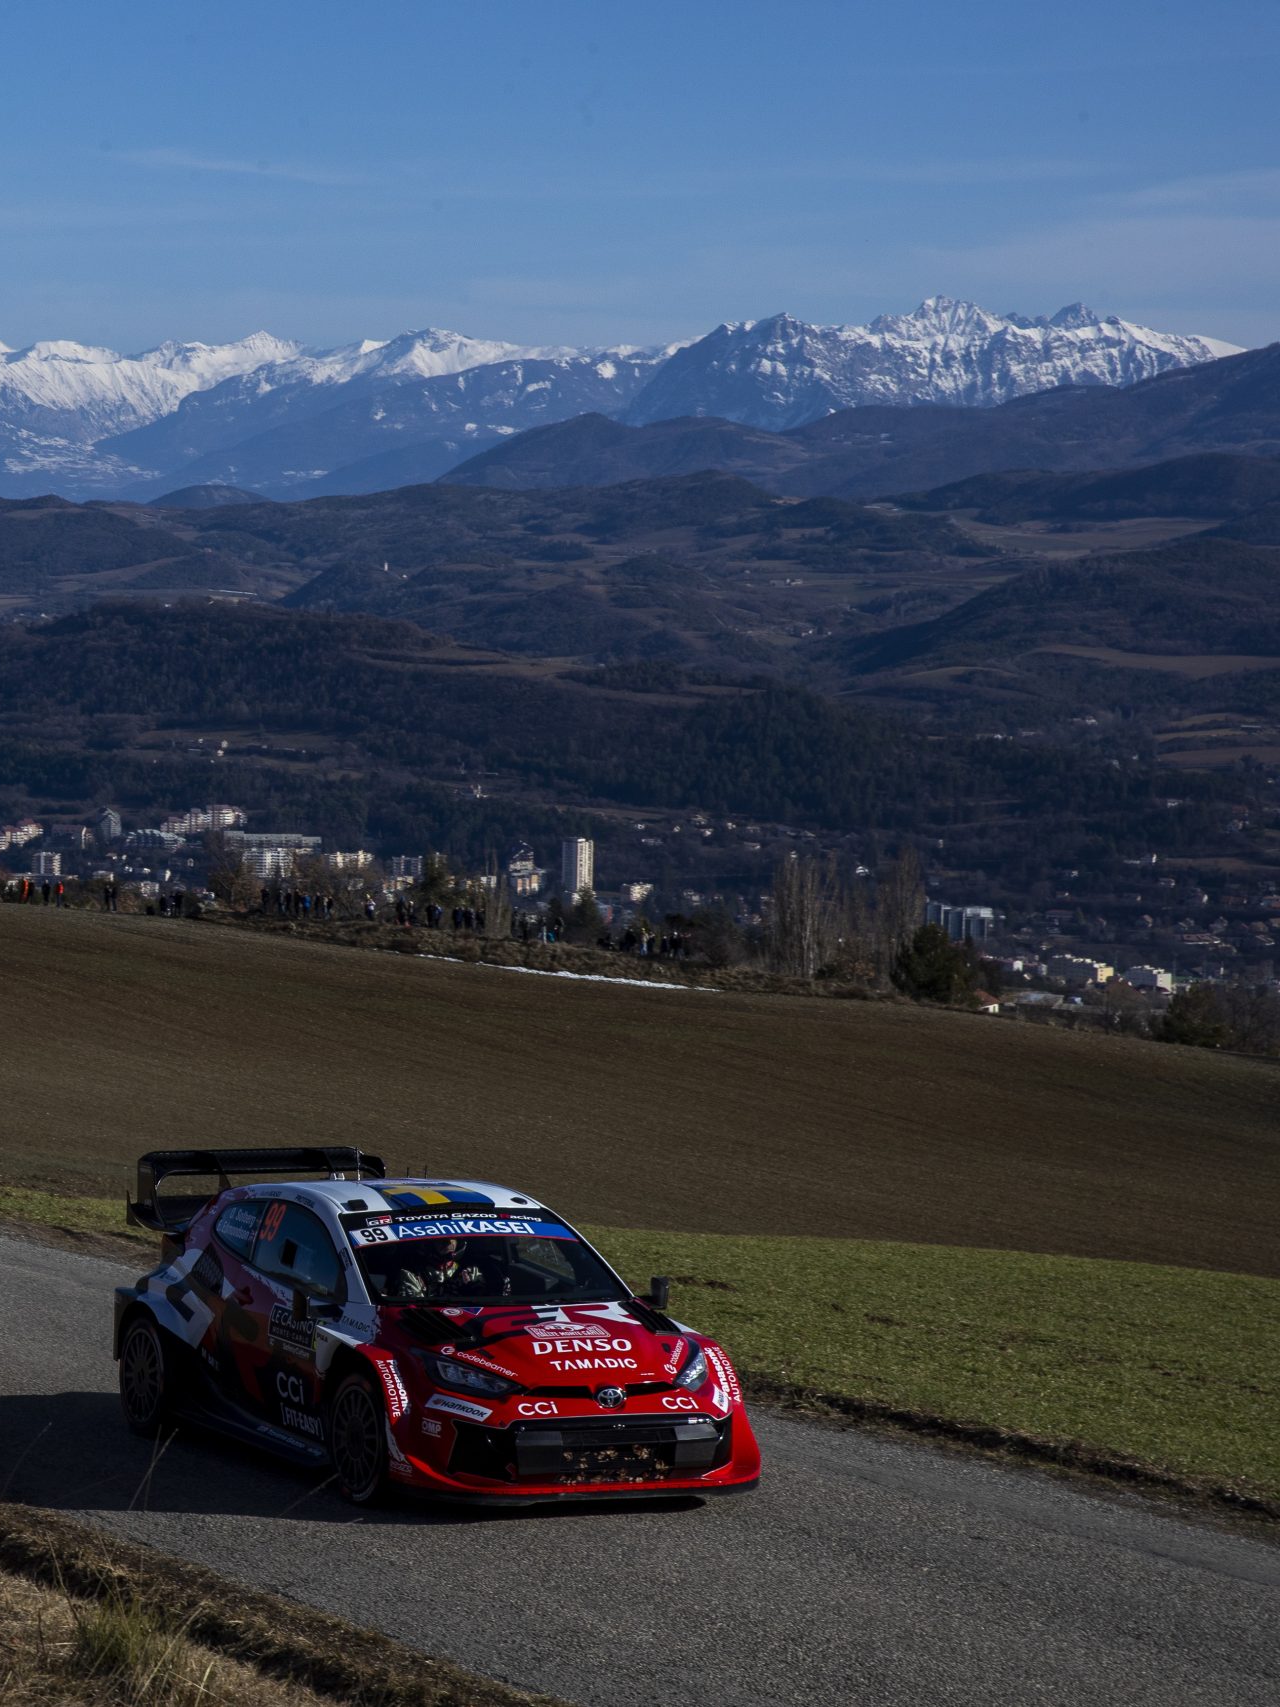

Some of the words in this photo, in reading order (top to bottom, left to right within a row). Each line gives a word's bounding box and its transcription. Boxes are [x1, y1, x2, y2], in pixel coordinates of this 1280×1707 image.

[258, 1200, 288, 1242] 99
[368, 1217, 391, 1226] GR
[395, 1214, 448, 1222] TOYOTA
[498, 1213, 542, 1222] Racing
[359, 1228, 389, 1243] 99
[399, 1221, 535, 1238] AsahiKASEI
[342, 1315, 370, 1333] TAMADIC
[531, 1338, 633, 1356] DENSO
[457, 1350, 519, 1379] codebeamer
[550, 1358, 638, 1371] TAMADIC
[712, 1346, 742, 1403] AUTOMOTIVE
[376, 1360, 402, 1418] AUTOMOTIVE
[421, 1418, 443, 1435] OMP
